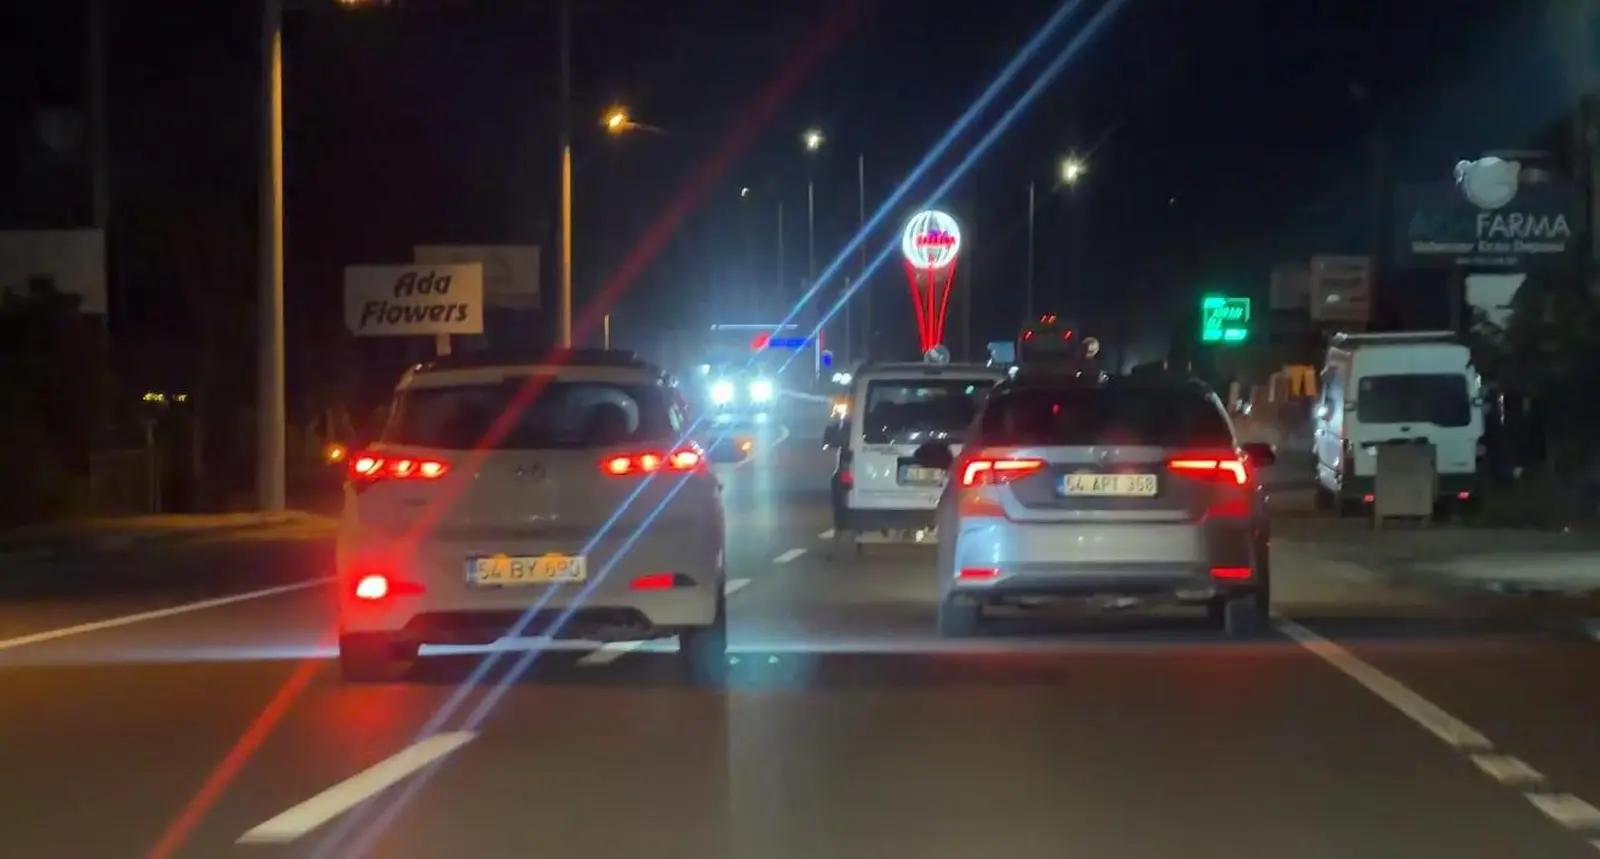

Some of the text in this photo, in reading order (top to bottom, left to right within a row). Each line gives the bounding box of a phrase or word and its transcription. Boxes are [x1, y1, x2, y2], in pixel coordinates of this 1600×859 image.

[1476, 212, 1572, 238] FARMA
[394, 271, 453, 298] Ada
[359, 300, 468, 330] Flowers
[479, 560, 502, 580] 54
[510, 560, 537, 579] BY
